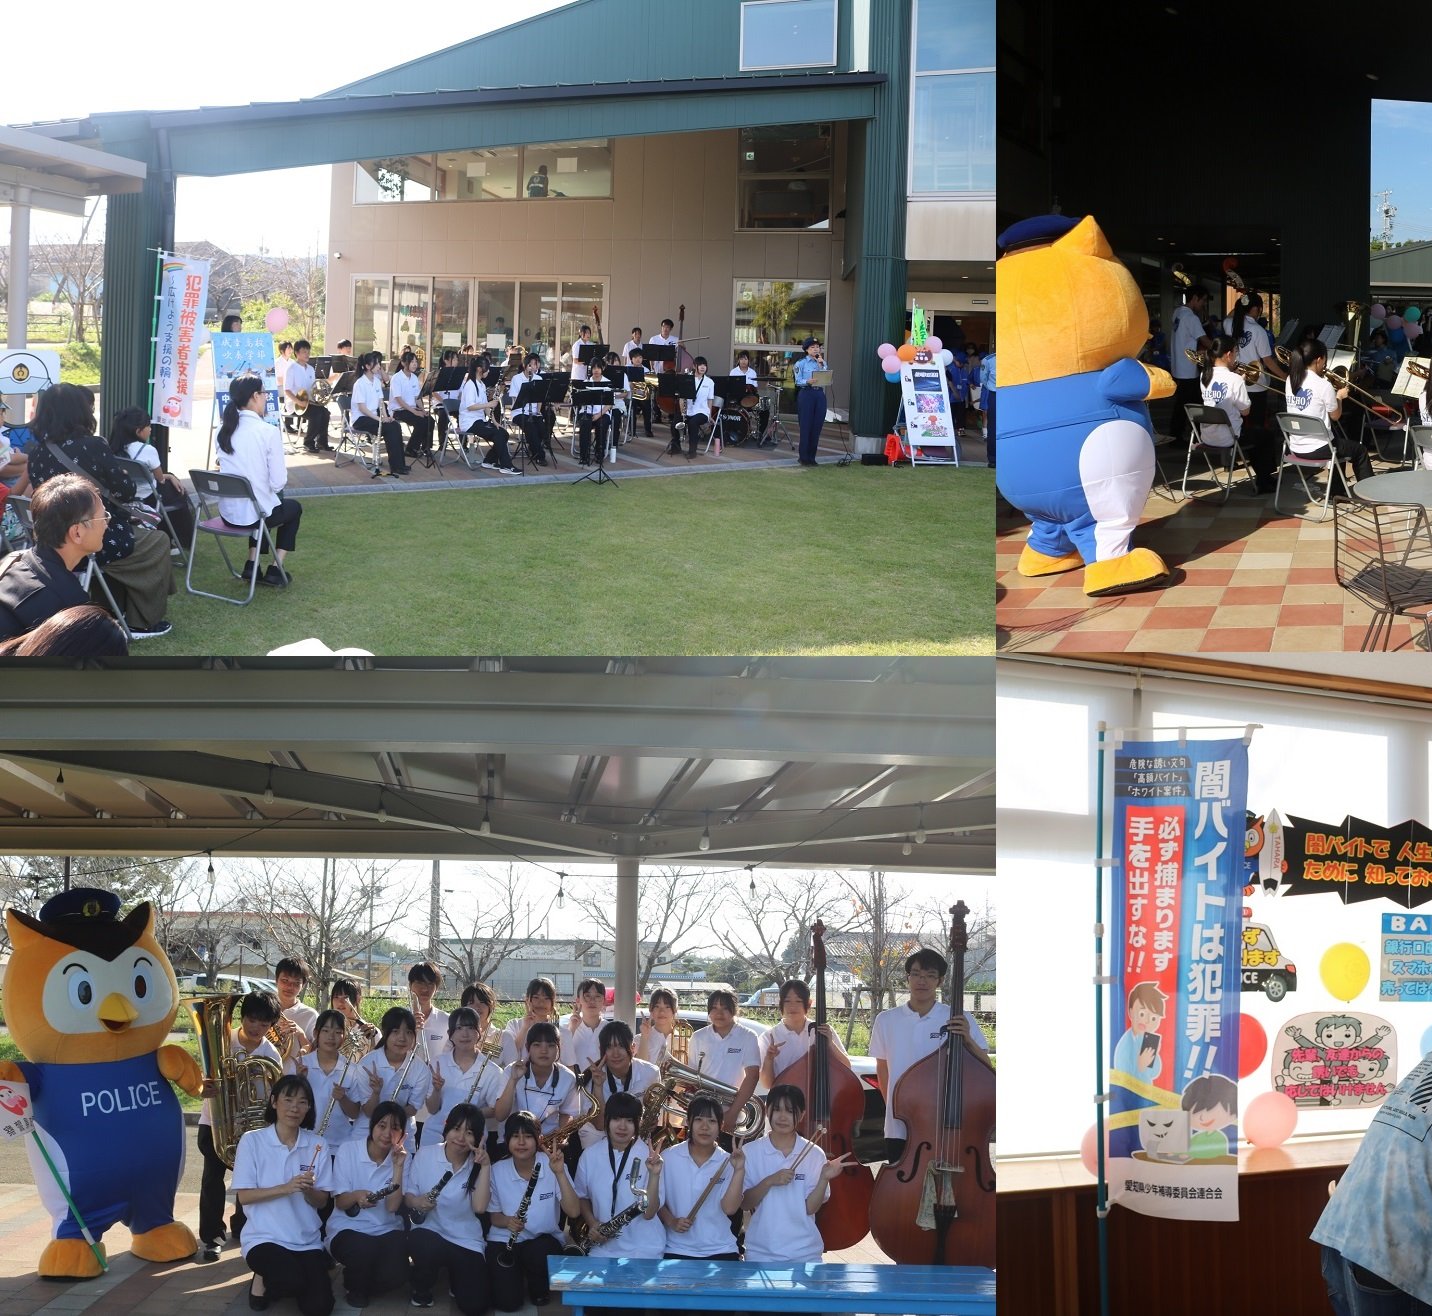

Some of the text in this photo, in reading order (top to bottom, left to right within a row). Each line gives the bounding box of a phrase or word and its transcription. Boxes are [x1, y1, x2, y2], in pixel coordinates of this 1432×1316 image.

[176, 274, 203, 396] 犯罪被害者支援
[1128, 757, 1187, 769] 危険な誘い文句
[1127, 785, 1187, 797] 「ホワイト案件」
[1272, 836, 1281, 869] TAHARA
[1304, 832, 1391, 859] 闇バイトで
[1303, 859, 1359, 883] ために
[1151, 816, 1181, 973] 必ず捕まります
[81, 1081, 162, 1117] POLICE
